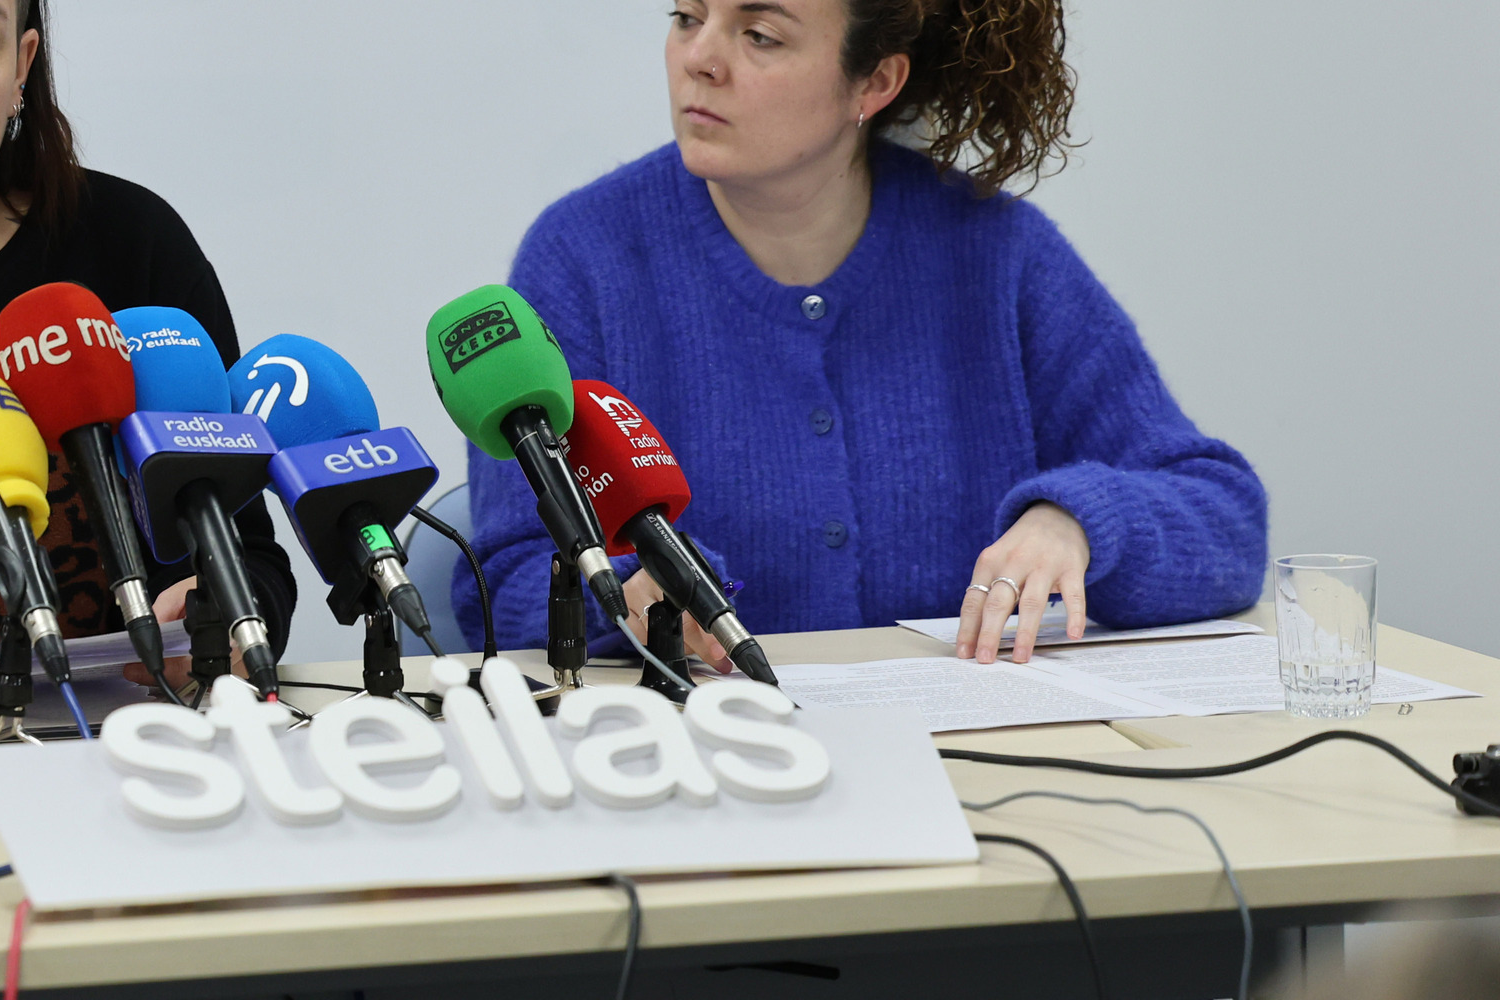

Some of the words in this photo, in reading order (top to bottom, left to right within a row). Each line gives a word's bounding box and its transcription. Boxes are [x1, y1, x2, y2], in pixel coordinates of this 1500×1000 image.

[142, 328, 181, 340] radio
[449, 313, 500, 342] ONDA
[76, 317, 132, 362] rne
[146, 336, 202, 349] euskadi
[458, 326, 506, 356] CERO
[164, 416, 224, 432] radio
[173, 433, 258, 449] euskadi
[629, 433, 661, 449] radio
[323, 438, 399, 474] etb
[631, 450, 678, 469] nervión
[100, 656, 832, 829] steilas
